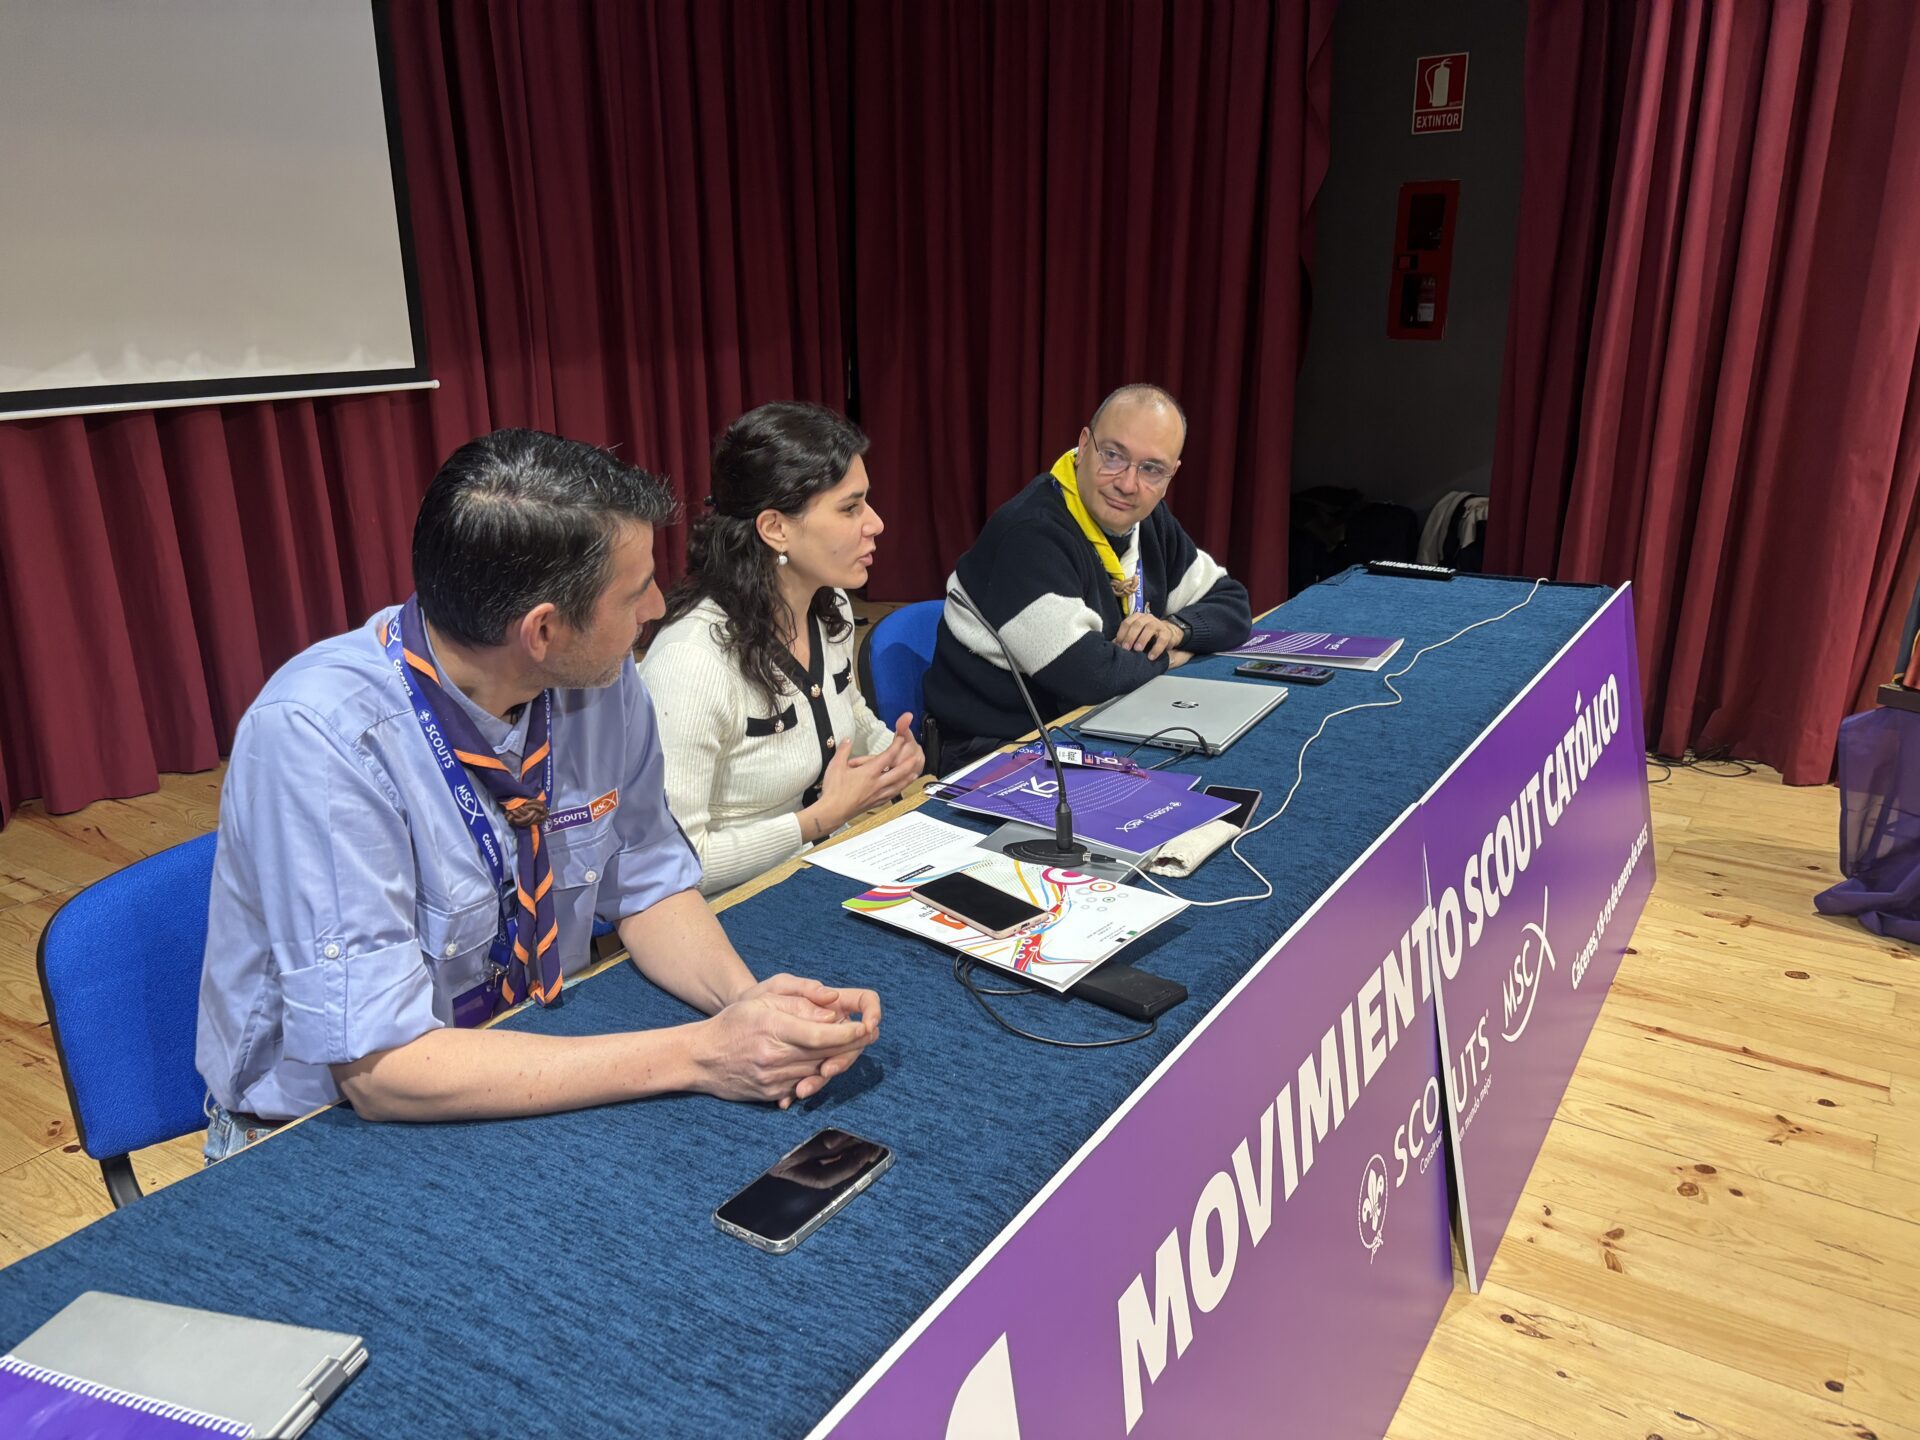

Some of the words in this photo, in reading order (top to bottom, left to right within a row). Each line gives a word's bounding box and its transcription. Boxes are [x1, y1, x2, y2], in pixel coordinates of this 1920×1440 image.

[1416, 113, 1459, 128] EXTINTOR
[425, 723, 455, 769] SCOUTS
[457, 784, 474, 808] MSC
[482, 833, 499, 867] Cáceres
[553, 811, 589, 826] SCOUTS
[1611, 882, 1619, 911] de
[1618, 857, 1632, 897] enero
[1631, 842, 1638, 869] de
[1117, 886, 1463, 1436] MOVIMIENTO
[1463, 771, 1544, 948] SCOUT
[1543, 673, 1620, 828] CATÓLICO
[1395, 1013, 1489, 1188] SCOUTS
[1465, 1095, 1480, 1131] mundo
[1480, 1073, 1492, 1102] mejor
